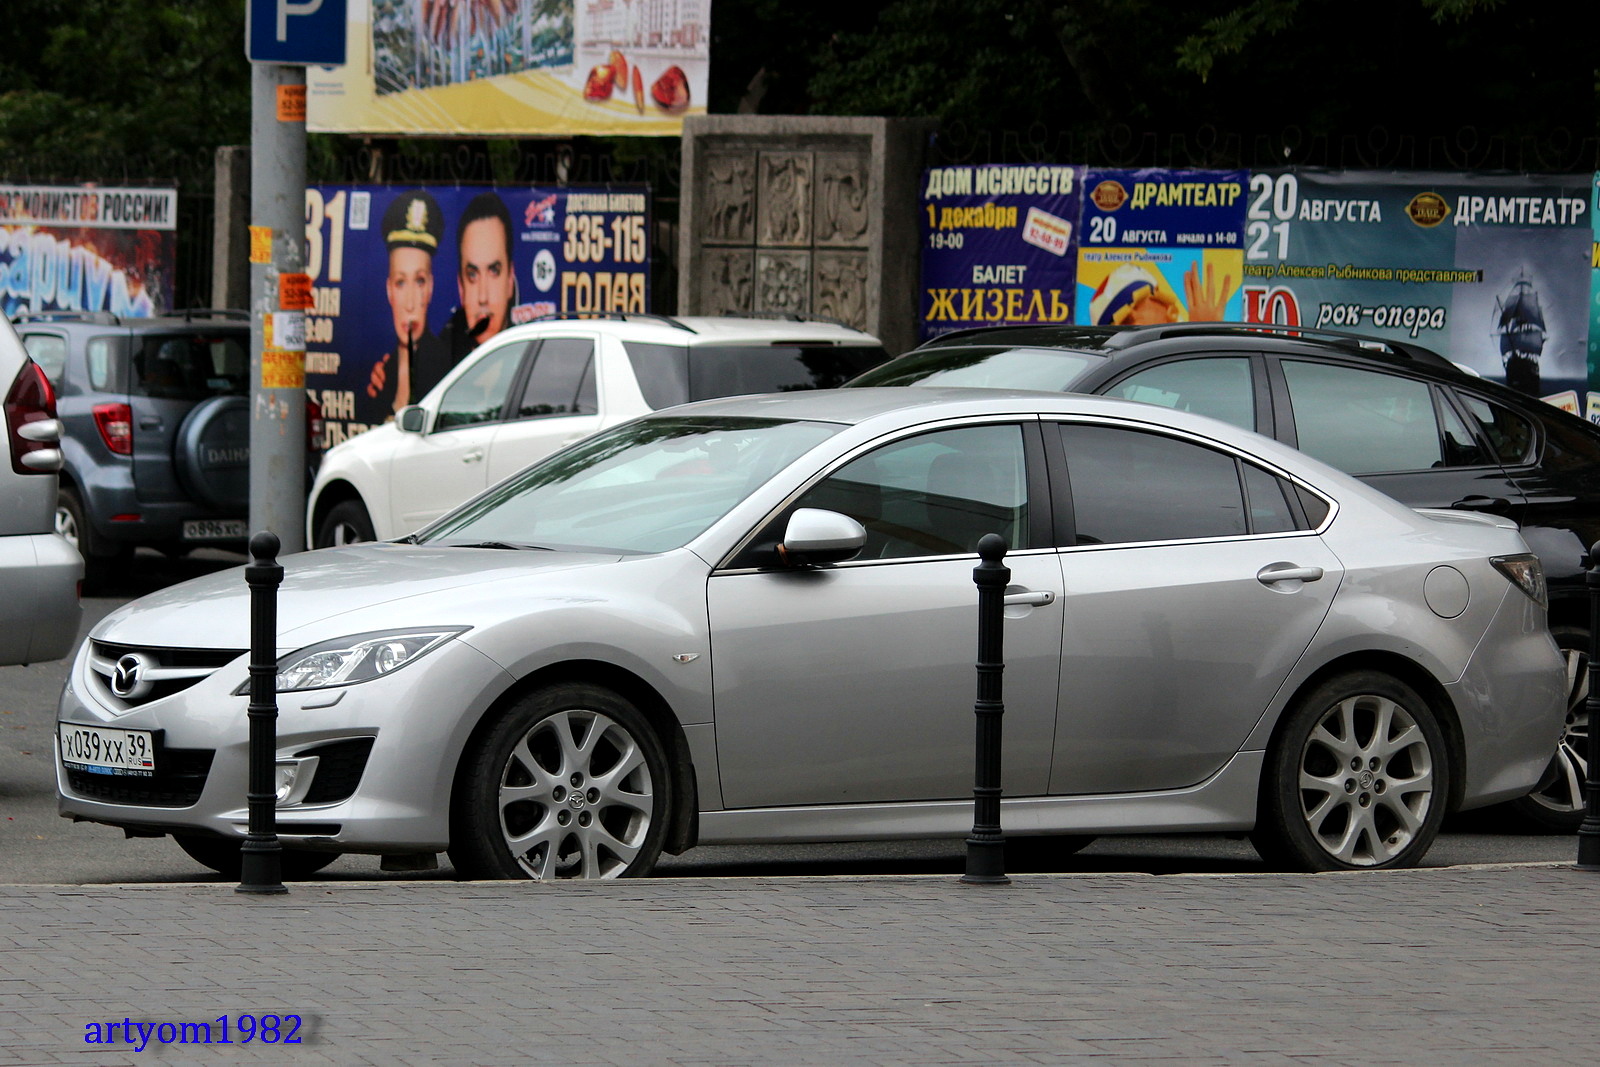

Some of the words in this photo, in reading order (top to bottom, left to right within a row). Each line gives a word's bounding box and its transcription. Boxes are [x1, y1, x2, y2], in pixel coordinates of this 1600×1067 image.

[925, 169, 969, 199] ДОМ
[975, 166, 1075, 197] ИСКУССТВ
[1130, 183, 1242, 211] ДРАМТЕАТР
[1247, 173, 1298, 221] 20
[1299, 199, 1382, 223] АВГУСТА
[1453, 196, 1586, 227] ДРАМТЕАТР
[927, 204, 936, 229] 1
[939, 202, 1017, 231] декабря
[1089, 216, 1117, 244] 20
[1122, 229, 1168, 244] АВГУСТА
[564, 214, 646, 263] 335-115
[929, 233, 964, 250] 19-00
[1247, 221, 1291, 260] 21
[973, 264, 1028, 285] БАЛЕТ
[1243, 265, 1274, 280] театр
[1277, 263, 1325, 278] Алексея
[1327, 265, 1393, 280] Рыбникова
[561, 271, 646, 320] ГОЛАЯ
[926, 287, 1070, 323] ЖИЗЕЛЬ
[1316, 301, 1447, 338] рок-опера
[127, 734, 145, 757] 39
[129, 757, 142, 766] RUS
